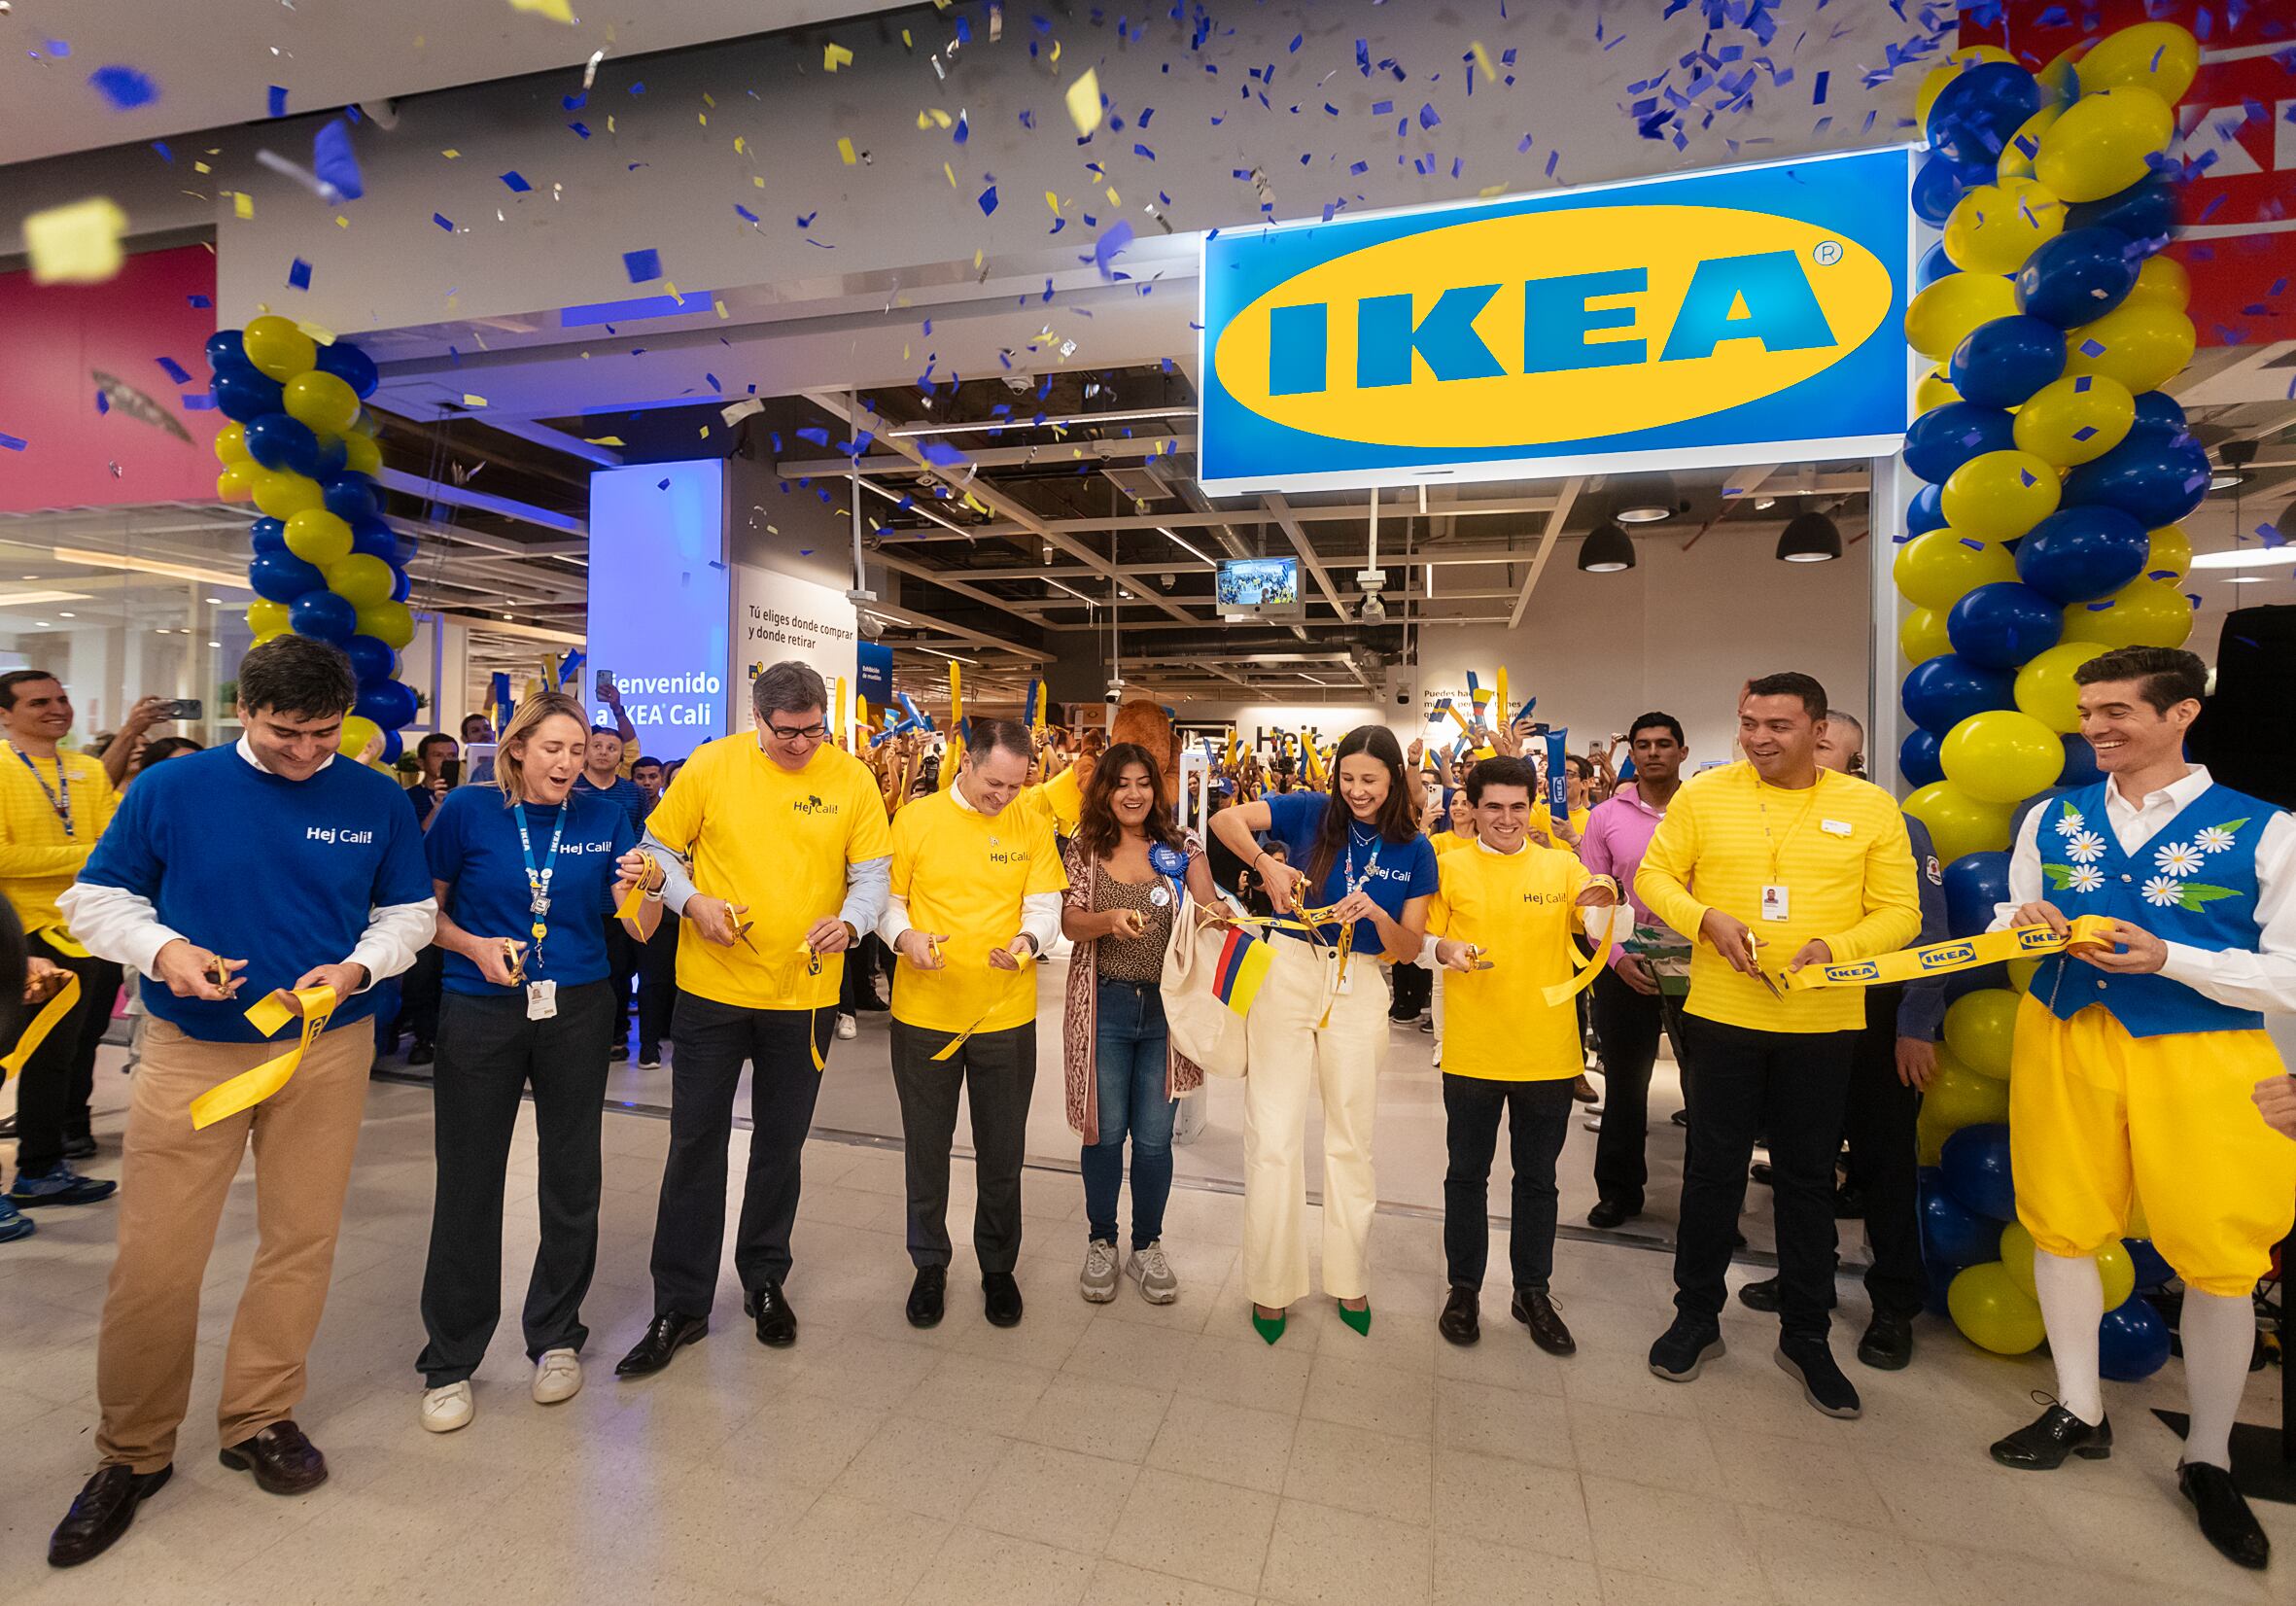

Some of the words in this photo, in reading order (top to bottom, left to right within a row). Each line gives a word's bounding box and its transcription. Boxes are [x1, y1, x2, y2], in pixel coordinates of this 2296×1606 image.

[1269, 250, 1839, 397] IKEA
[748, 605, 761, 619] Tú
[763, 609, 790, 627] eliges
[791, 615, 818, 632] donde
[819, 624, 853, 641] comprar
[748, 626, 755, 640] y
[756, 626, 785, 643] donde
[787, 634, 817, 649] retirar
[611, 671, 720, 694] ienvenido
[595, 709, 609, 725] a
[669, 703, 711, 725] Cali
[793, 801, 813, 816] Hej
[815, 803, 838, 815] Cali!
[306, 826, 336, 844] Hej
[339, 829, 373, 844] Cali!
[560, 842, 583, 855] Hej
[585, 842, 612, 853] Cali!
[990, 852, 1008, 864] Hej
[1523, 892, 1544, 905] Hej
[1546, 892, 1566, 903] Cali!
[1925, 948, 1969, 963] IKEA
[1830, 966, 1874, 977] IKEA
